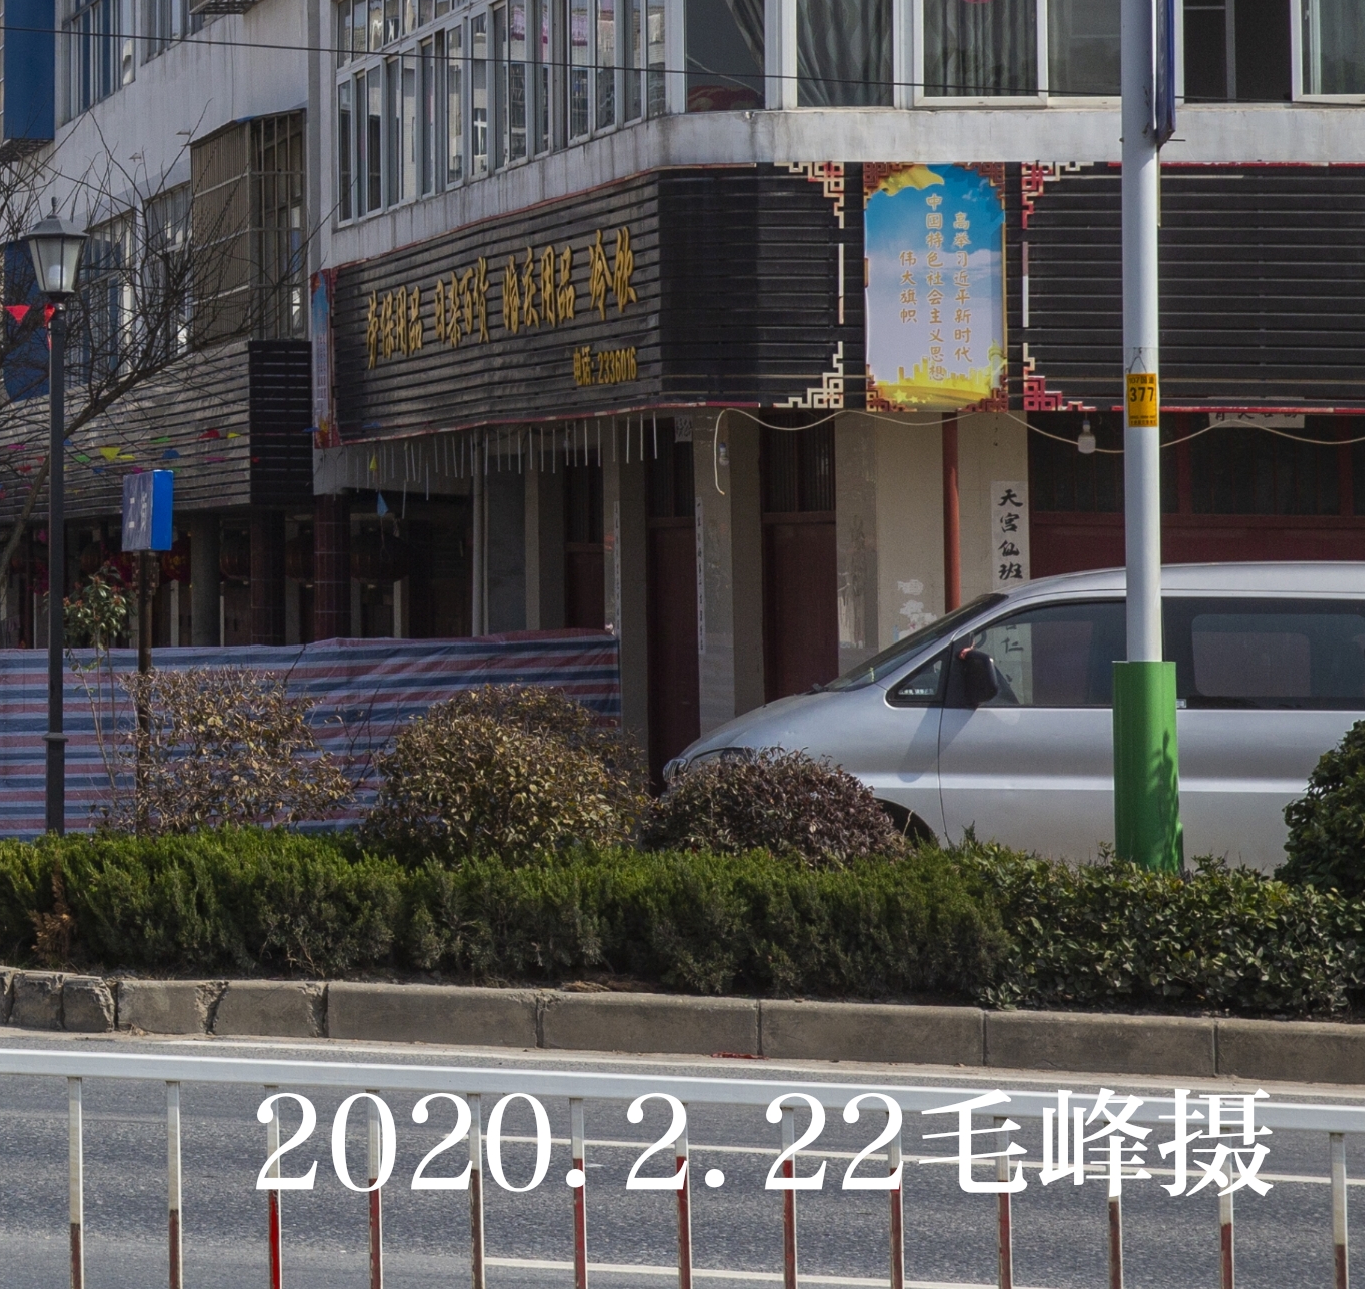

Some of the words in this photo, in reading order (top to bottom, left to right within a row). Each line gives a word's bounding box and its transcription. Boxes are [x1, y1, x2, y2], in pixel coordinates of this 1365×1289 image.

[366, 285, 423, 370] 劳保用品
[502, 244, 575, 334] 婚庆用品
[588, 226, 638, 321] 冷饮
[899, 250, 917, 324] 伟大旗帜
[925, 193, 946, 382] 中国特色社会主义思想
[953, 211, 973, 363] 高举习近平新时代
[1130, 386, 1154, 402] 377
